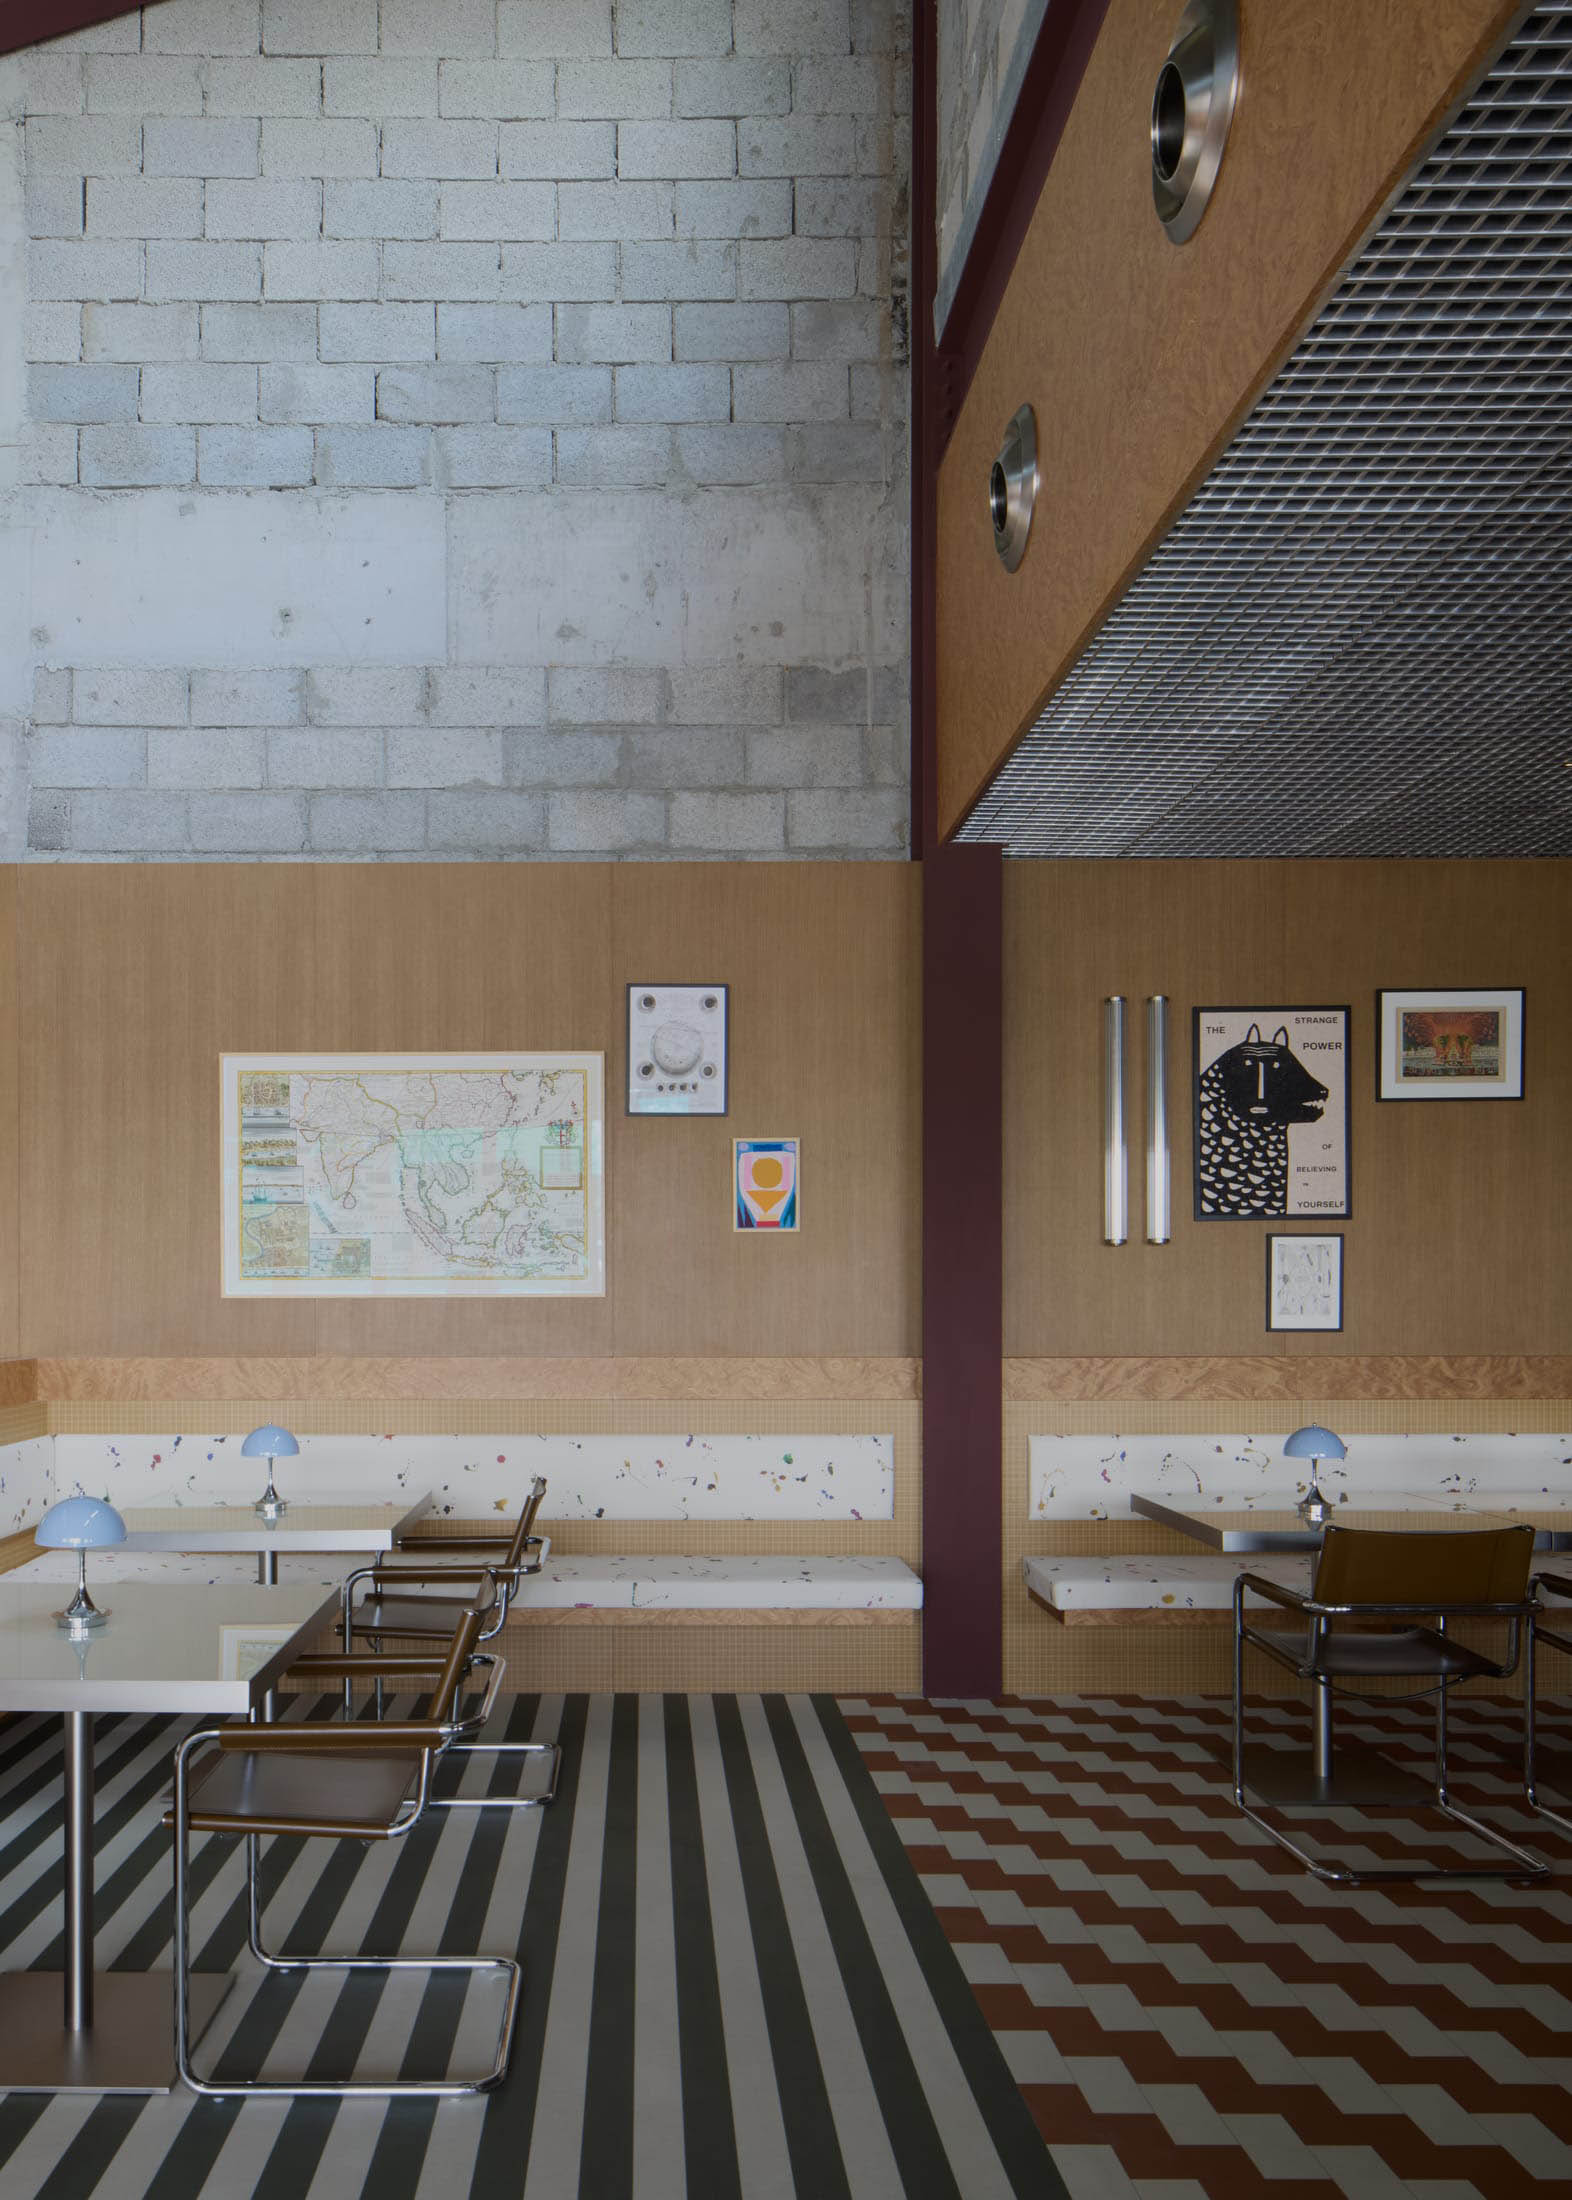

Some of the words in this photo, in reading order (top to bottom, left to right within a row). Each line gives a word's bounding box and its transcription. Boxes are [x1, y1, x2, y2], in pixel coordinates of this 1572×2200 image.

[1295, 1016, 1338, 1024] STRANGE
[1206, 1026, 1226, 1034] THE
[1303, 1042, 1342, 1050] POWER
